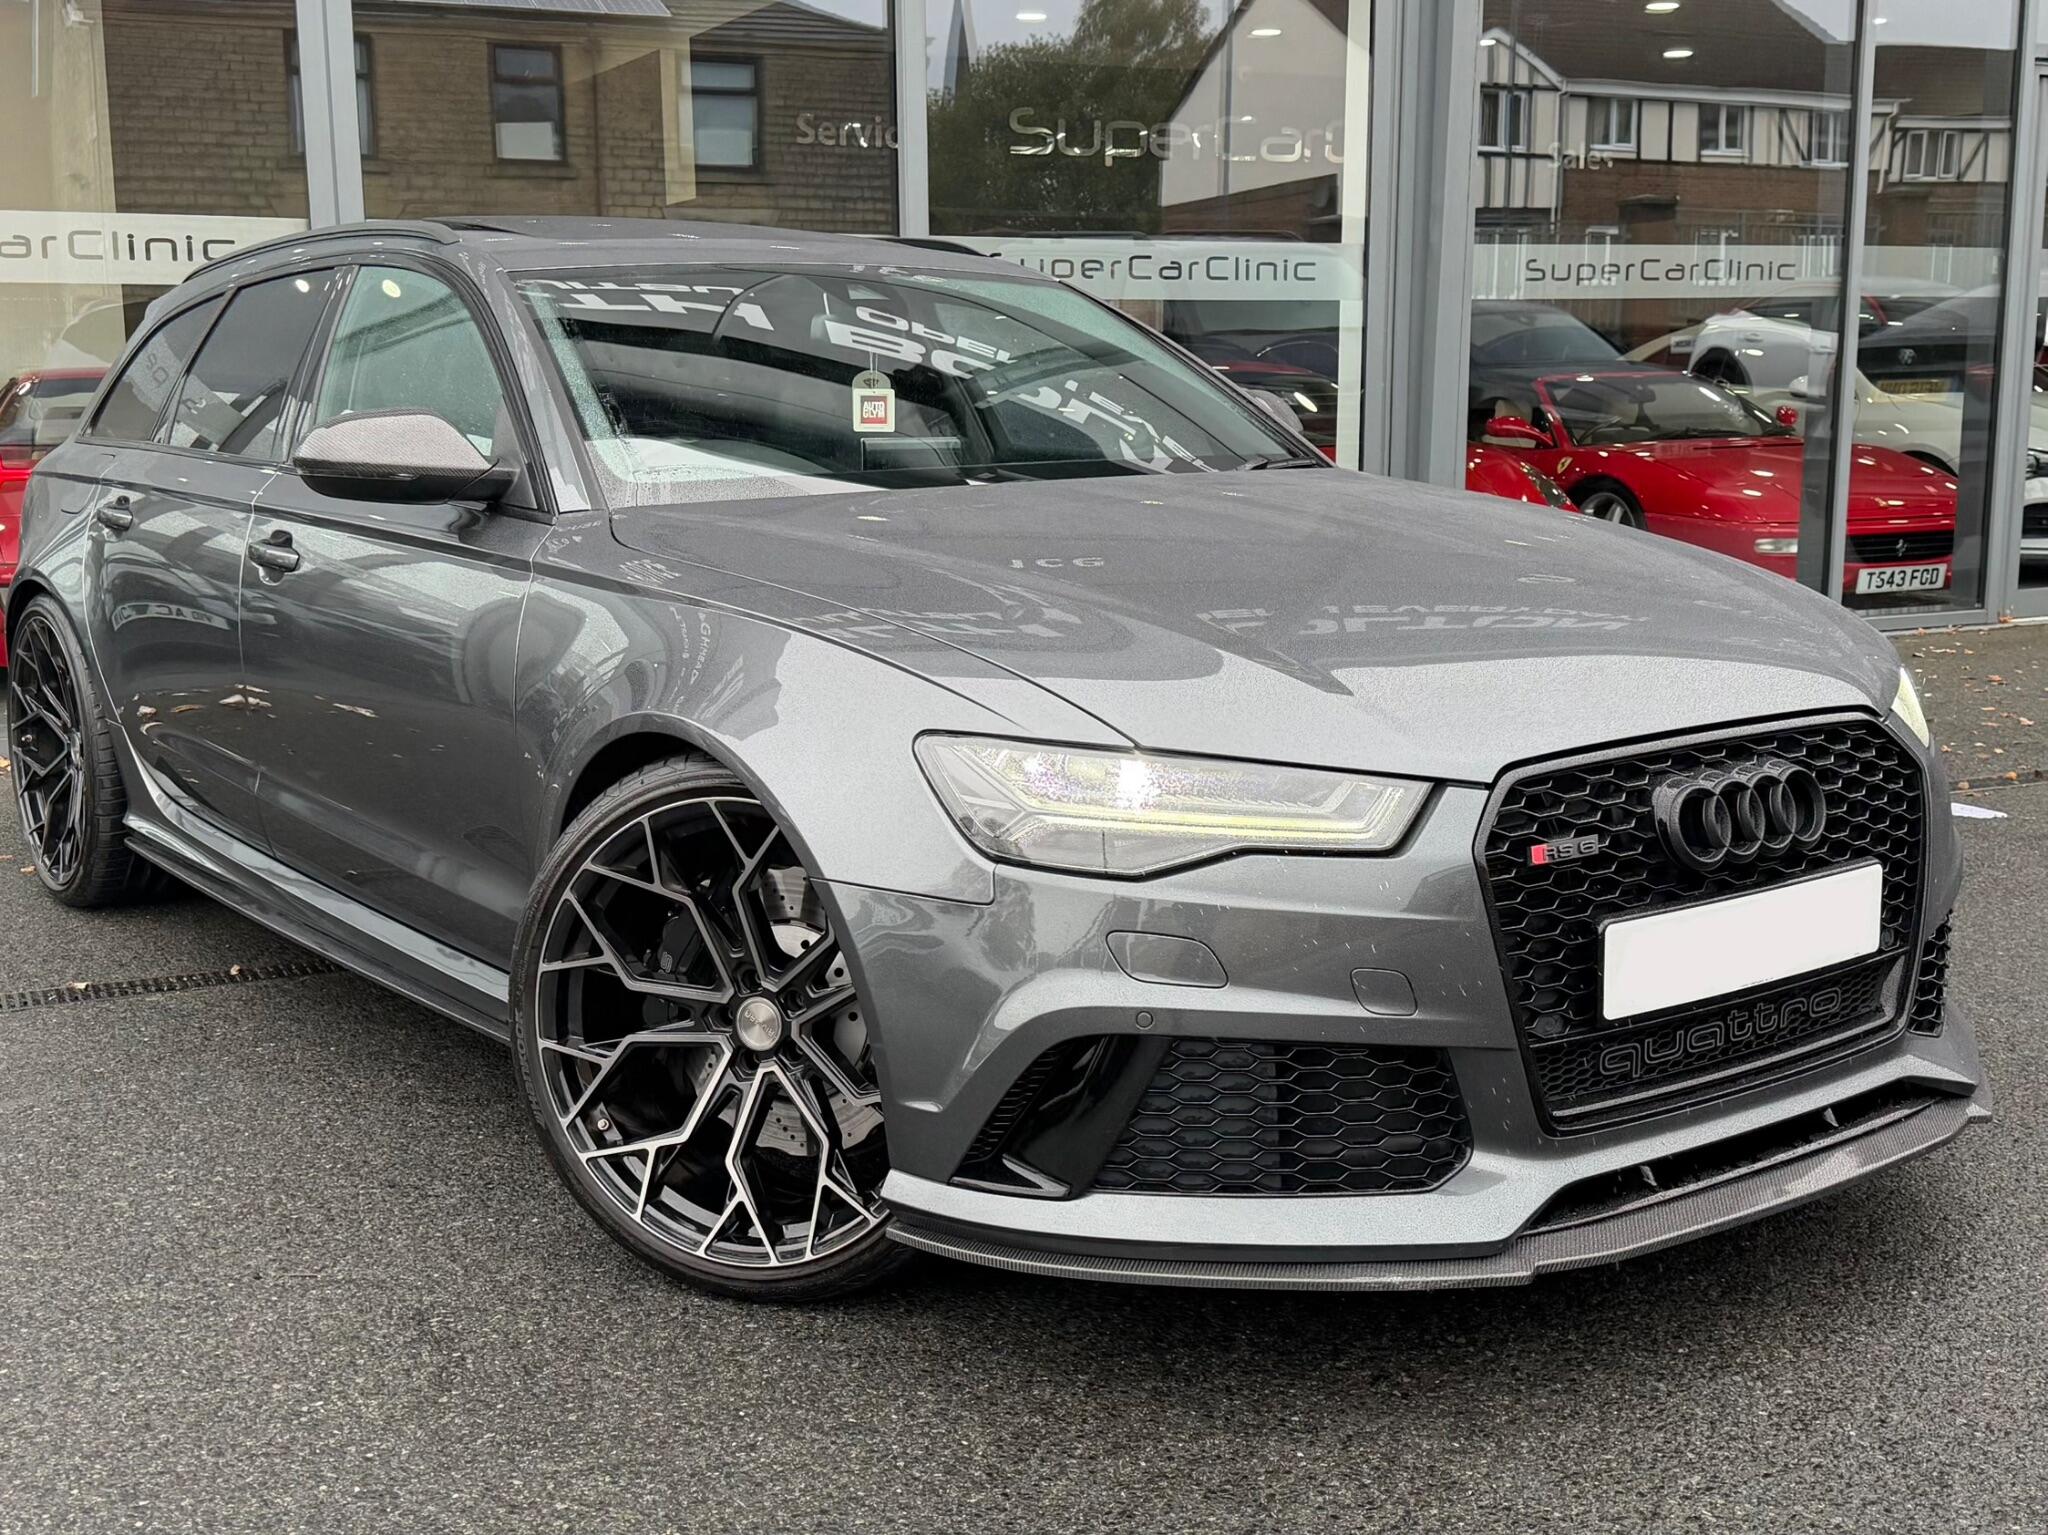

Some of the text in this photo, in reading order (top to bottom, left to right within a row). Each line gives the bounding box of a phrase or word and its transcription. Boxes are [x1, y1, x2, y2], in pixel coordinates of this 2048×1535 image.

[1525, 258, 1796, 286] SuperCarClinic
[863, 401, 886, 411] AUTO
[1866, 569, 1907, 590] T543
[1579, 839, 1597, 854] 6
[1600, 987, 1841, 1078] quattro
